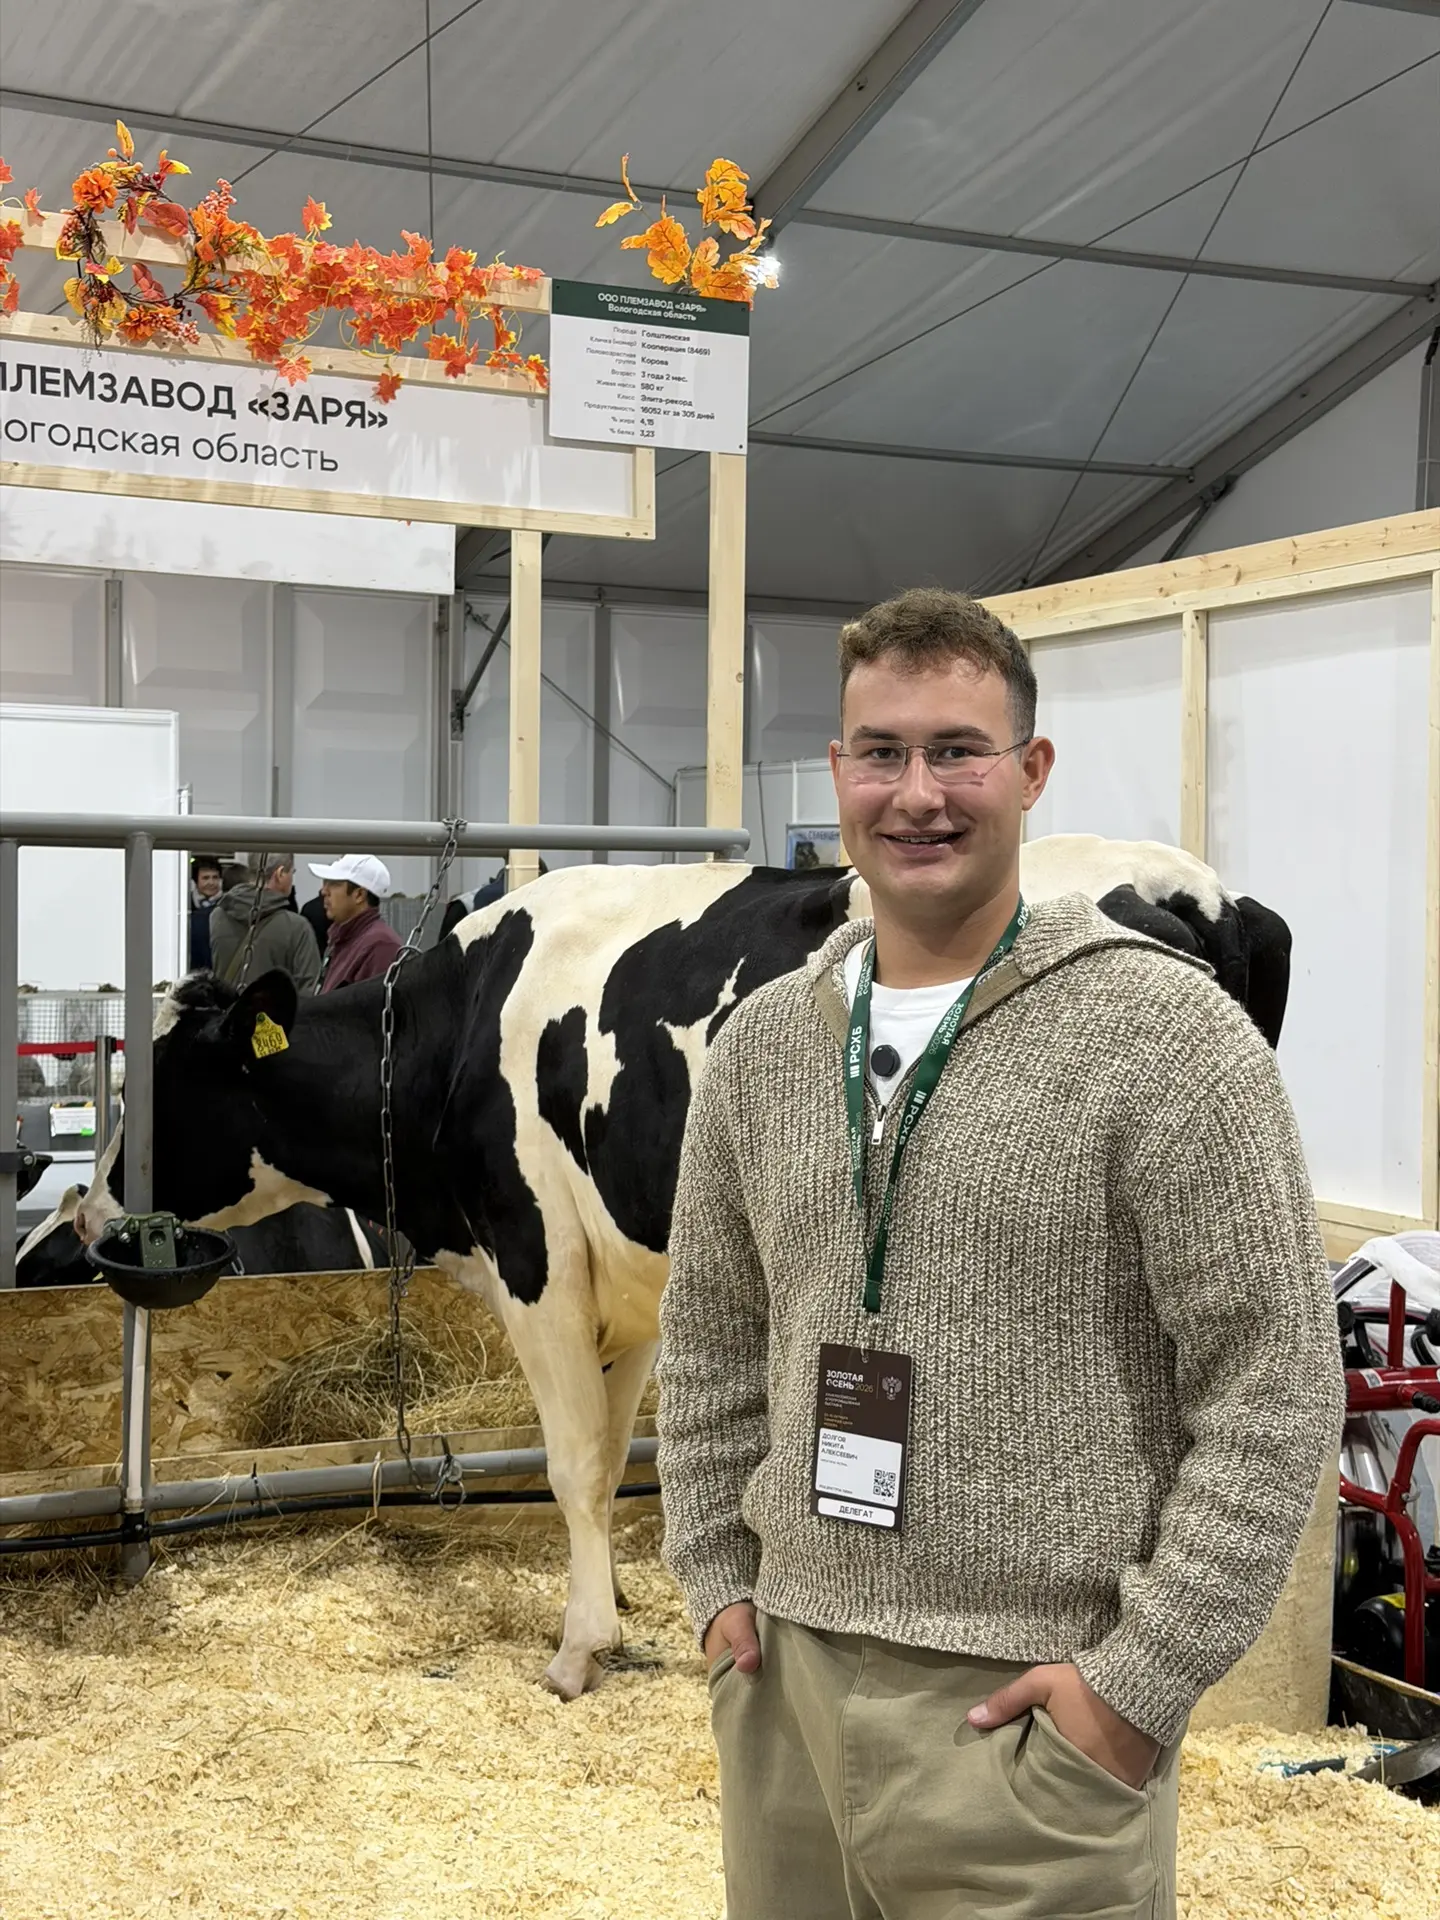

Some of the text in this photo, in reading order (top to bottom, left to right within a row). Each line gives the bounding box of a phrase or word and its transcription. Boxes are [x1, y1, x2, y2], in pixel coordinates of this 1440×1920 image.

[598, 293, 707, 313] ООО ПЛЕМЗАВОД «ЗАРЯ»
[608, 303, 697, 321] Вологодская область
[641, 330, 690, 342] Голштинская
[641, 342, 686, 355] Кооперация
[687, 347, 711, 356] (8469)
[641, 357, 669, 367] Корова
[647, 373, 664, 381] года
[641, 382, 654, 391] 580
[0, 361, 389, 431] ЛЕМЗАВОД «ЗАРЯ»
[640, 394, 693, 407] Элита-рекорд
[640, 406, 661, 415] 16052
[663, 409, 671, 417] кг
[682, 410, 695, 419] 305
[696, 411, 715, 421] дней
[640, 418, 654, 426] 4,15
[640, 429, 655, 438] 3,23
[0, 417, 339, 473] огодская область
[941, 1003, 964, 1045] ЗОЛОТАЯ
[256, 1032, 283, 1052] 8469
[850, 1026, 863, 1064] РСХБ
[928, 1033, 943, 1055] 2026
[826, 1369, 864, 1383] ЗОЛОТАЯ
[825, 1378, 873, 1393] ОСЕНЬ 2026
[821, 1433, 846, 1442] ДОЛГОВ
[821, 1441, 844, 1450] НИКИТА
[821, 1449, 858, 1460] АЛЕКСЕЕВИЧ
[838, 1505, 873, 1518] ДЕЛЕГАТ
